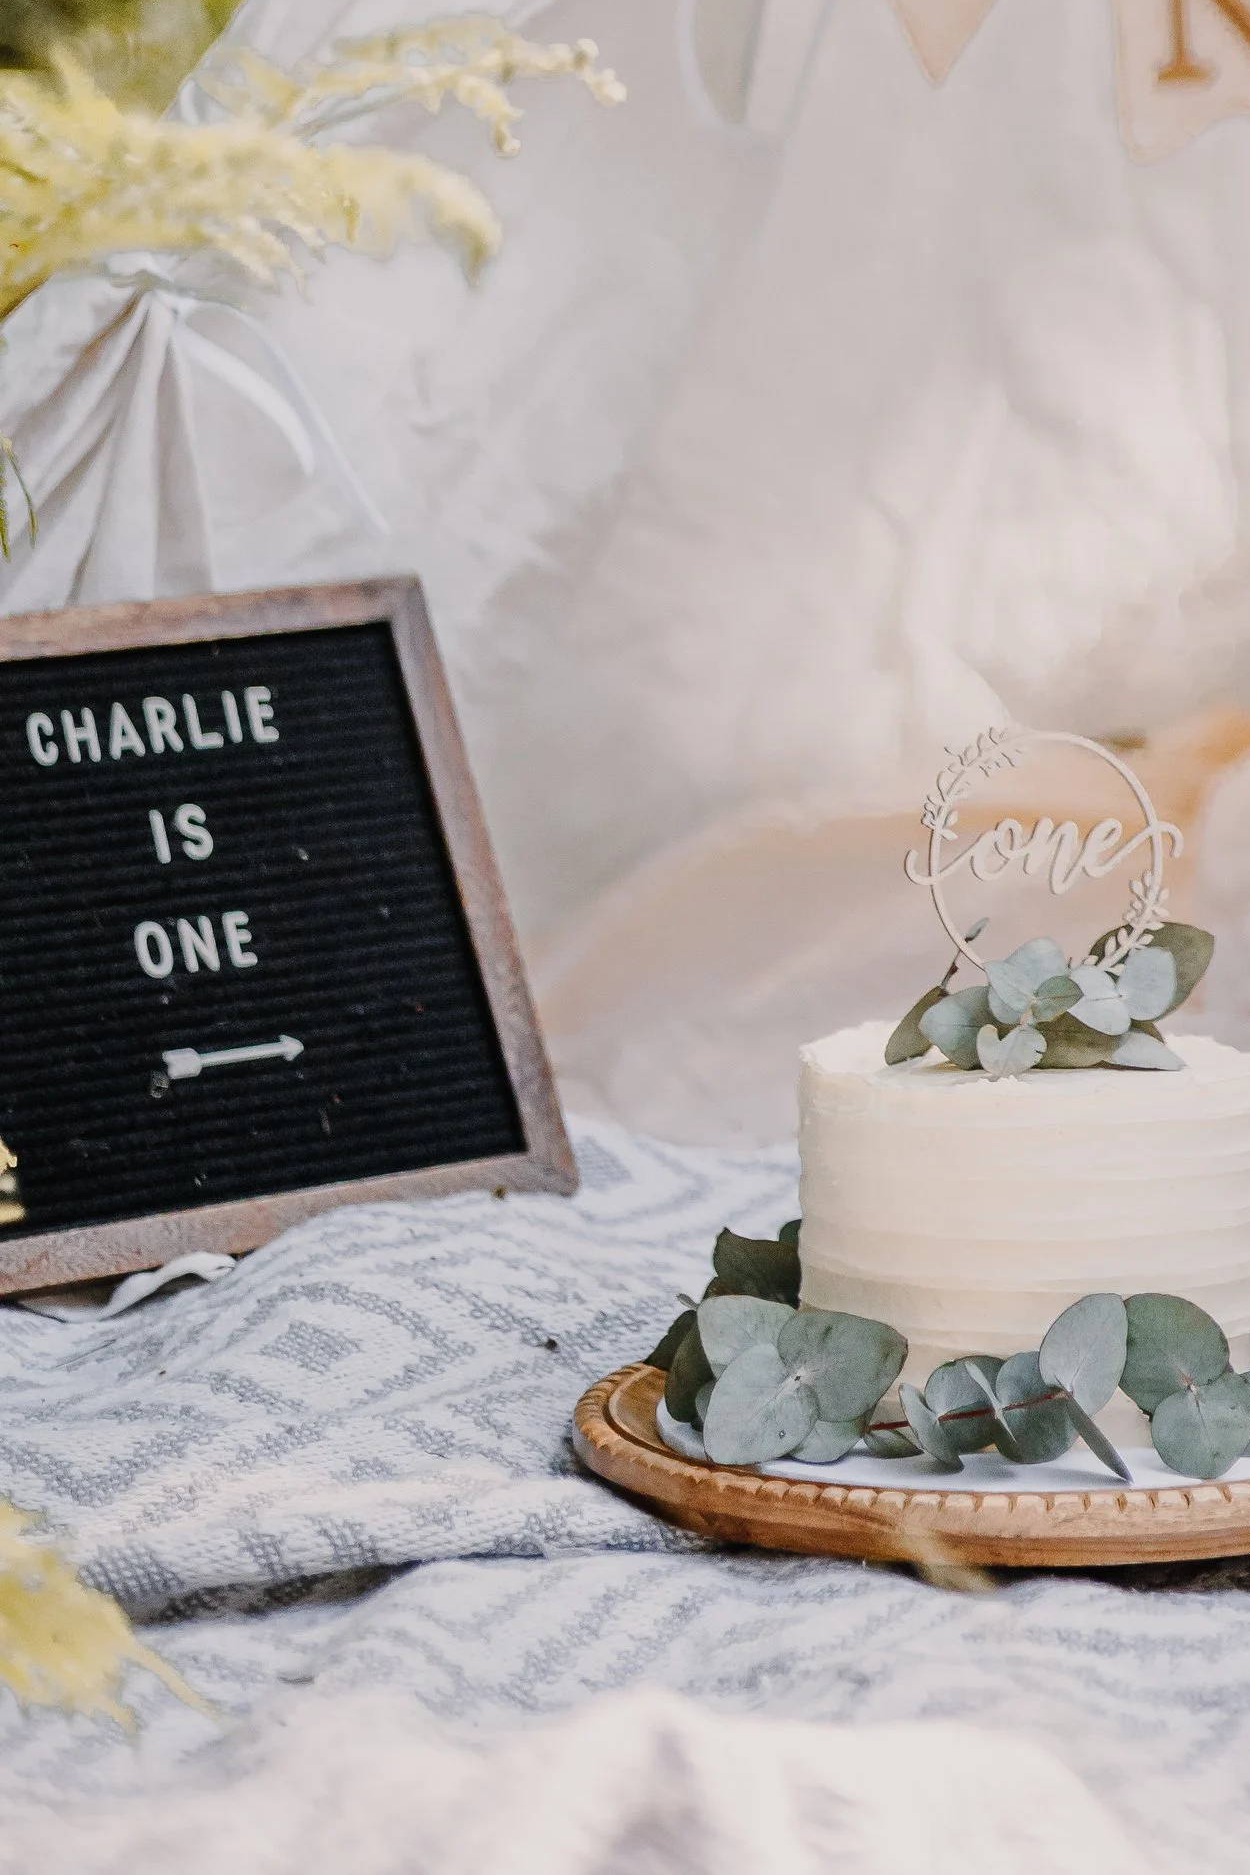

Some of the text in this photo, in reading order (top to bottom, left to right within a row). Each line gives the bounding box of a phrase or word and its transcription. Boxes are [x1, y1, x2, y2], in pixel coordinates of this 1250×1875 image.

[26, 685, 281, 767] CHARLIE
[148, 803, 215, 865] IS
[905, 816, 1183, 895] one
[133, 910, 259, 980] ONE
